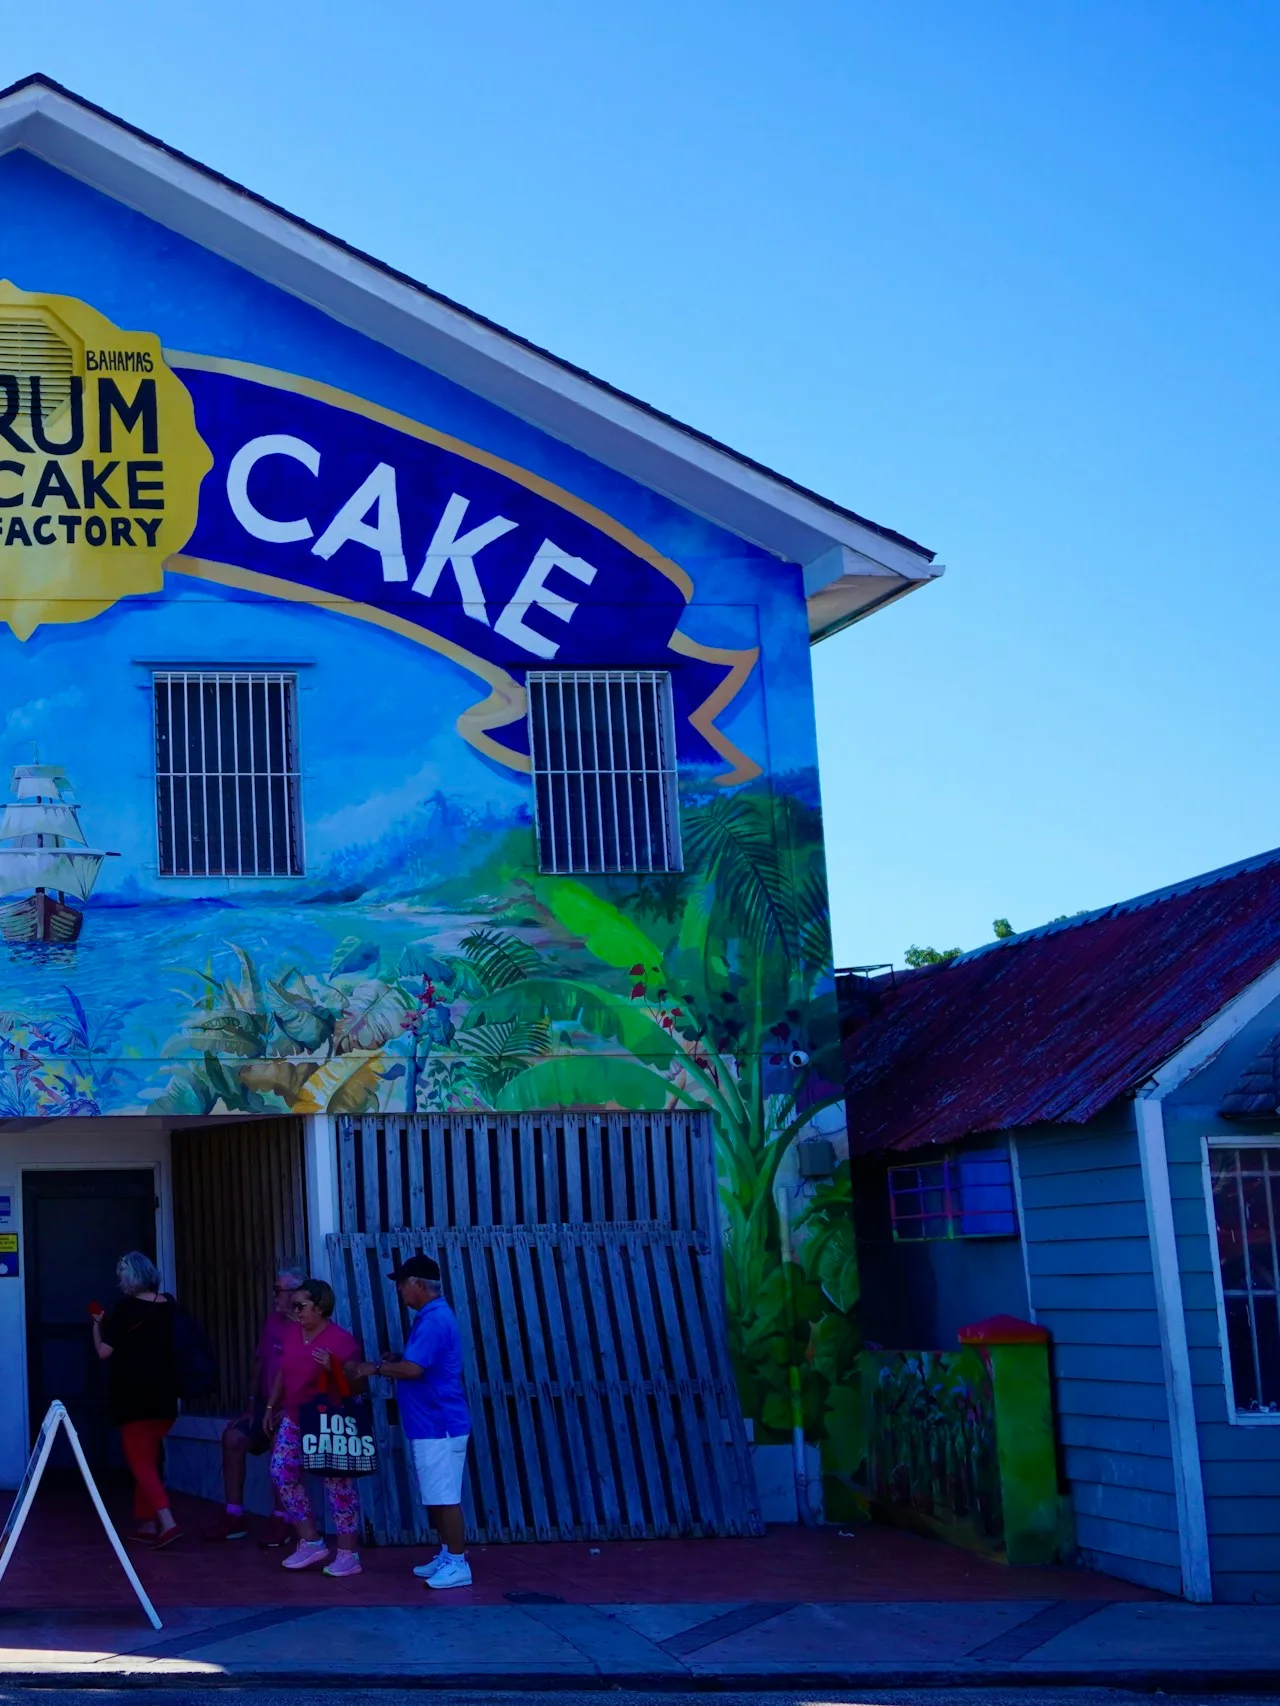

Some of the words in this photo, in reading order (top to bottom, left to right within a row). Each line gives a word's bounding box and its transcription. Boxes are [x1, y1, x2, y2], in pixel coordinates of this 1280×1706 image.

[86, 350, 154, 373] BAHAMAS
[226, 434, 598, 659] CAKE
[320, 1413, 358, 1436] LOS
[302, 1433, 375, 1456] CABOS
